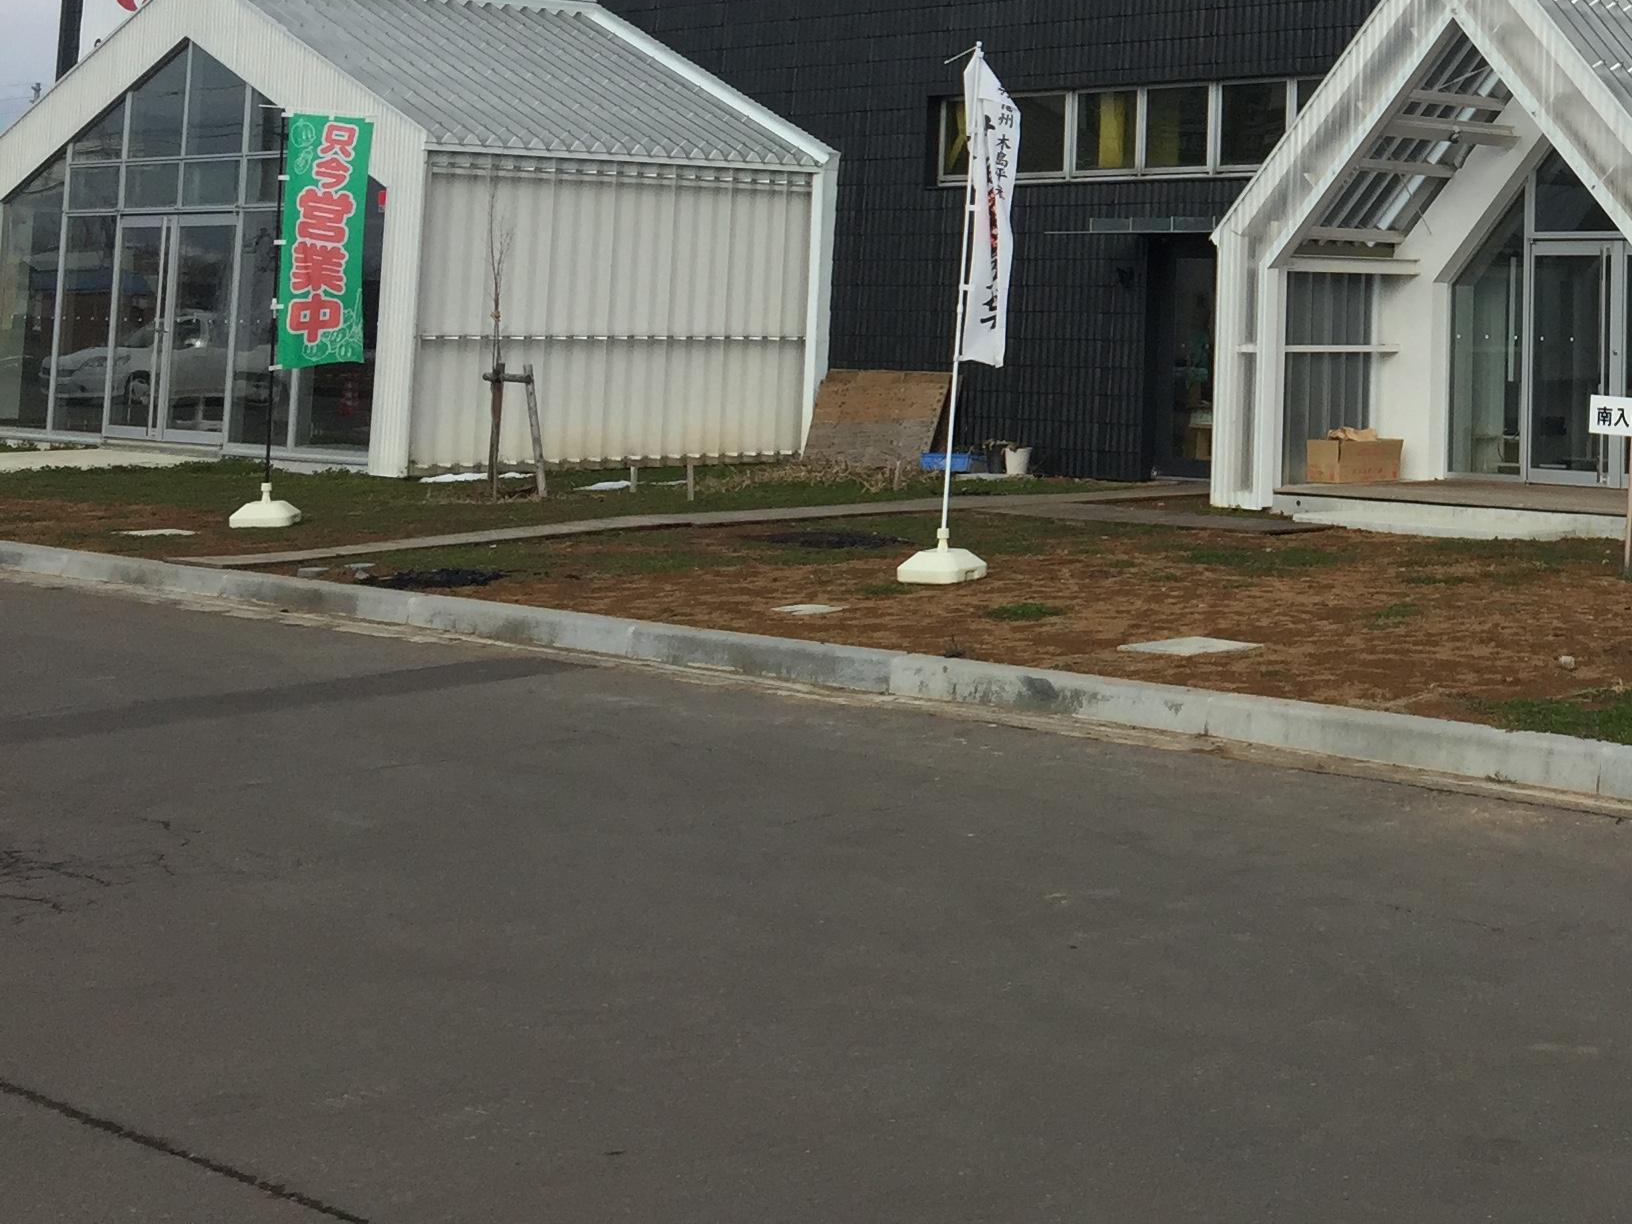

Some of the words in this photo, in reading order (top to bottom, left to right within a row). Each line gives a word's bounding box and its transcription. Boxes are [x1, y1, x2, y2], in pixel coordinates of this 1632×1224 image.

[287, 122, 358, 344] 只今営業中
